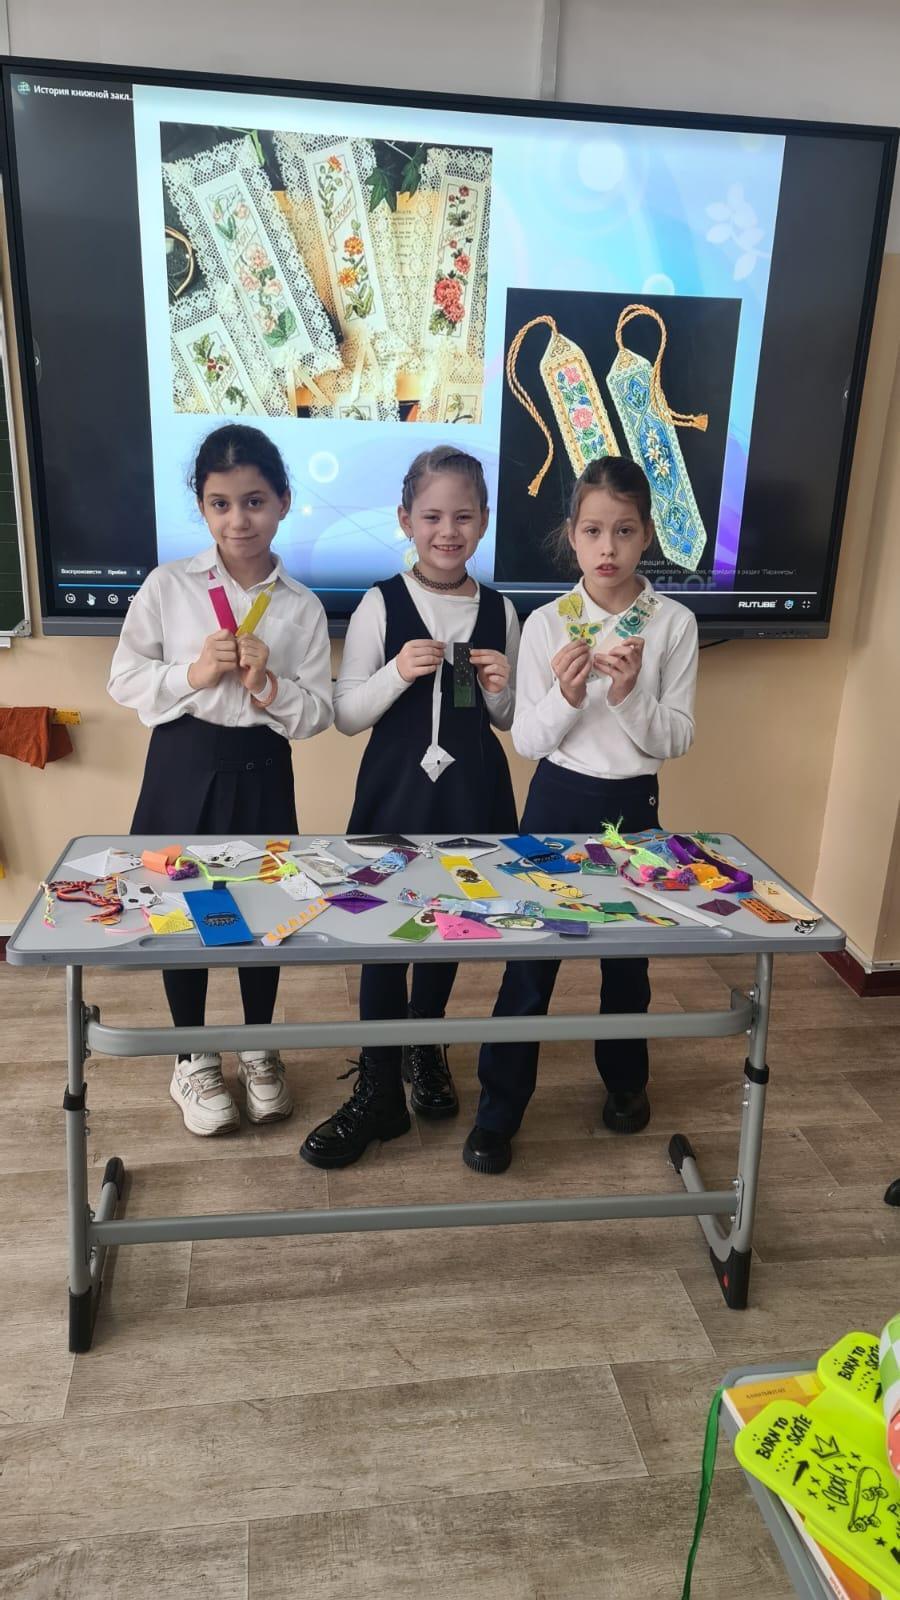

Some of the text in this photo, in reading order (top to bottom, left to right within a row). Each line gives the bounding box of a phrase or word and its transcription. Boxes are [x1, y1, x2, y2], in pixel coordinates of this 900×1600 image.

[33, 85, 70, 97] История
[71, 90, 109, 99] книжной
[837, 1345, 866, 1381] BORN TO
[864, 1344, 880, 1371] SKAT
[755, 1417, 789, 1460] BORN TO
[786, 1413, 813, 1447] SKATE
